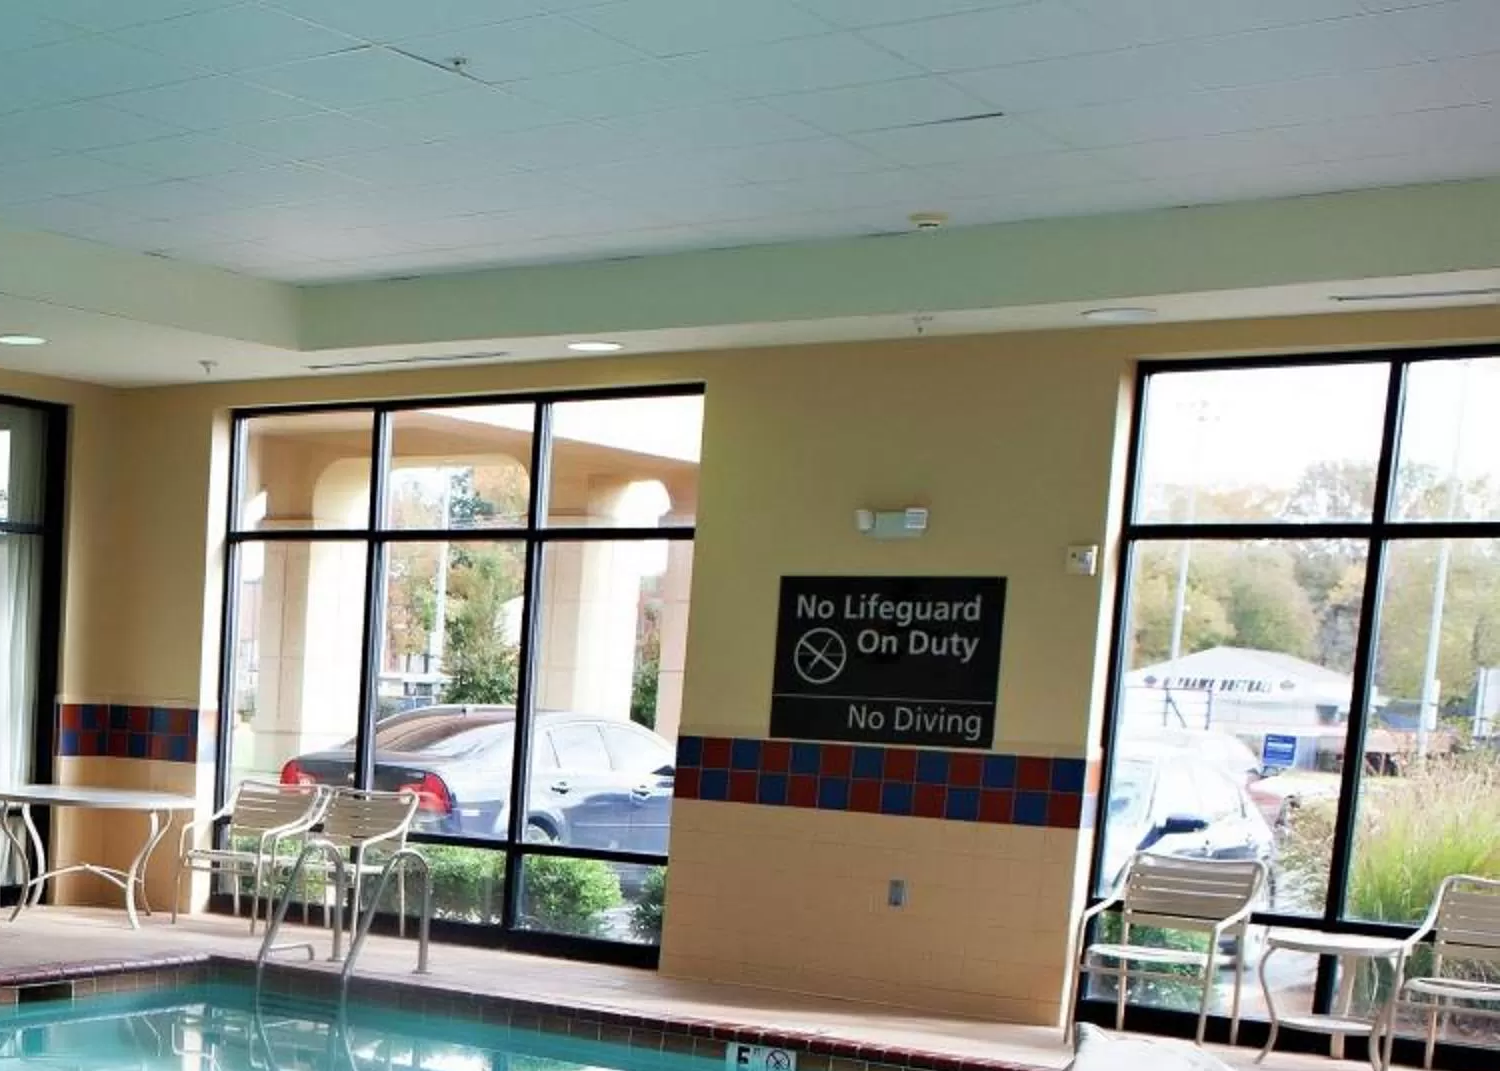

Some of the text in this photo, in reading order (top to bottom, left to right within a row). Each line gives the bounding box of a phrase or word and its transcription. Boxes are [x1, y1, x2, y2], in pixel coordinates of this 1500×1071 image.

[797, 594, 982, 626] No Lifeguard
[857, 629, 980, 663] On Duty
[847, 704, 982, 741] No Diving
